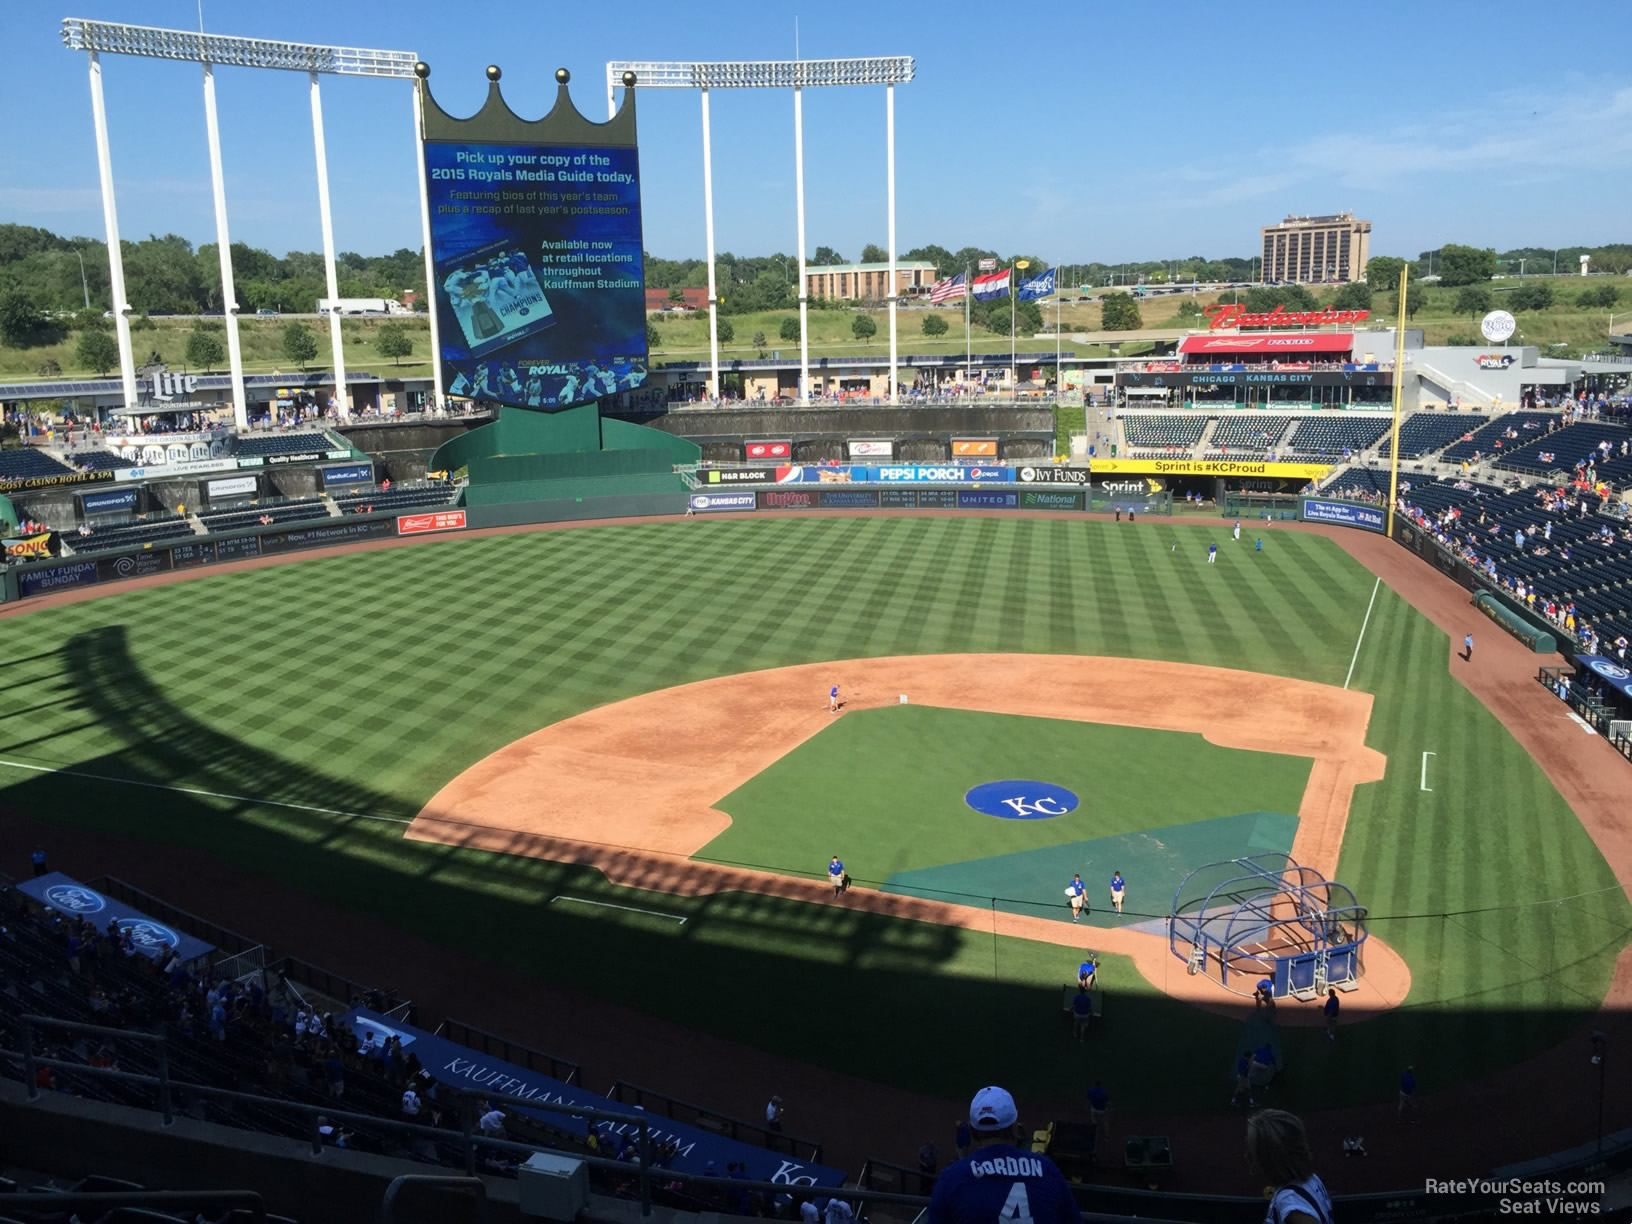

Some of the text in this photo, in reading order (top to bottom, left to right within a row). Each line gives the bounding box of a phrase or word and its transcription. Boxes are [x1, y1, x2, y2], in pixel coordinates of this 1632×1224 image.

[456, 151, 610, 167] Pick up your copy of the
[432, 168, 635, 185] 2015 Royals Media Guide today.
[450, 190, 618, 202] Featuring bios of this year's team
[438, 204, 460, 214] plus
[472, 205, 501, 215] recap
[503, 204, 514, 214] of
[516, 204, 535, 214] last
[537, 205, 569, 215] year's
[571, 206, 631, 215] postseason.
[541, 240, 613, 250] Available now
[542, 253, 633, 263] at retail locations
[543, 267, 602, 277] throughout
[544, 279, 640, 289] Kauffman Stadium
[500, 292, 543, 318] CHAMPIONS
[1204, 303, 1372, 330] Budweiser
[1483, 316, 1514, 336] 360
[1480, 358, 1510, 368] RIVALS
[528, 365, 569, 375] ROYAL
[152, 372, 198, 401] Lite
[168, 448, 187, 459] Lite
[192, 447, 209, 458] Lite
[269, 454, 319, 464] Quality Healthcare
[191, 462, 224, 471] FEARLESS
[1155, 462, 1265, 473] Sprint is #KCProud
[880, 468, 965, 480] PEPSI PORCH
[0, 471, 113, 491] GOSY CASINO HOTEL & SPA
[1240, 480, 1272, 489] Sprint
[1101, 480, 1144, 497] Sprint
[86, 498, 125, 508] GRUNDFOS
[711, 497, 754, 506] KANSAS CITY
[1036, 494, 1076, 504] National
[1320, 511, 1336, 519] Royals
[1336, 513, 1356, 521] Baseball
[1364, 513, 1382, 525] At Bat
[288, 534, 307, 542] Now,
[317, 528, 347, 538] Network
[7, 539, 49, 556] SONIC
[136, 553, 153, 561] Time
[20, 561, 97, 583] FAMILY FUNDAY
[41, 573, 82, 588] SUNDAY
[1000, 796, 1068, 816] KC
[51, 888, 96, 910] Ford
[970, 1156, 1043, 1179] GORDON
[998, 1182, 1035, 1224] 4
